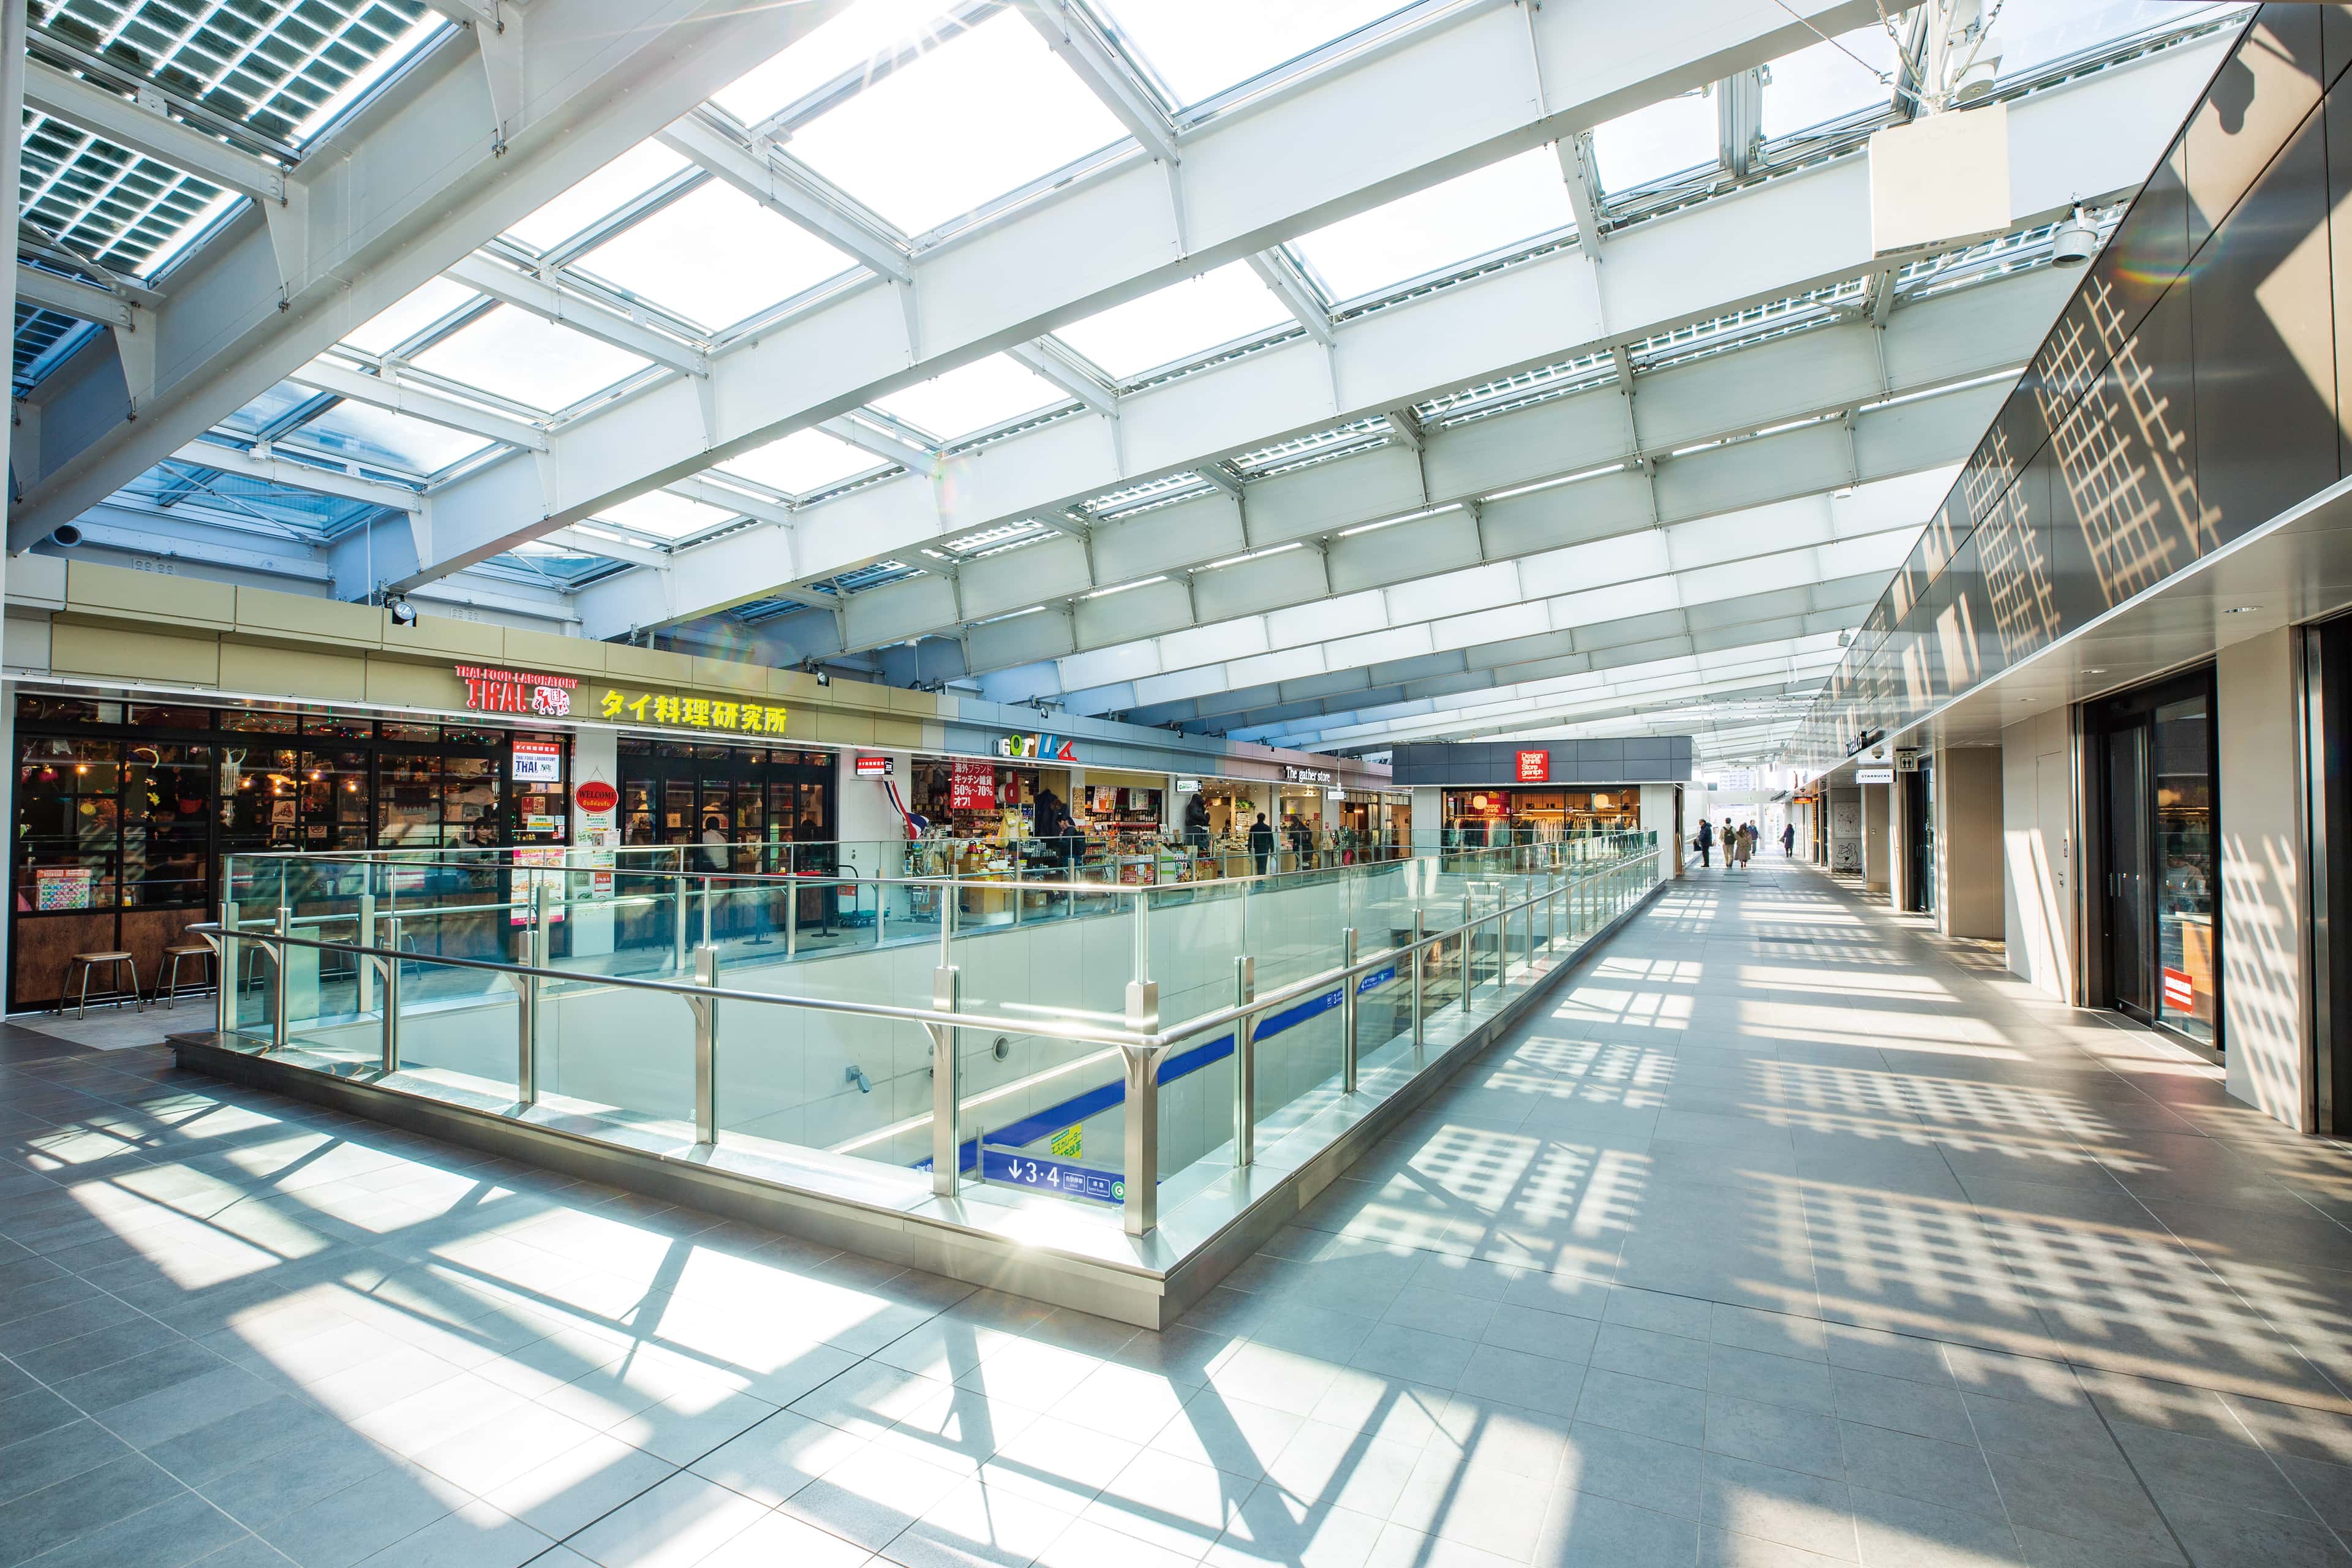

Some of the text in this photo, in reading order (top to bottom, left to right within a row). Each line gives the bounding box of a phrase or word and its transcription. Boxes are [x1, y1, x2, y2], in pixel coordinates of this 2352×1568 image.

[455, 665, 578, 689] THAI FOOD LABORATORY
[466, 679, 529, 712] THAI
[601, 690, 786, 733] タイ料理研究所
[516, 761, 538, 774] THAI
[954, 774, 992, 786] キッチン雑貨
[1286, 766, 1330, 783] The gather store
[578, 790, 615, 799] WELCOME
[1333, 993, 1336, 1004] 3
[1066, 1175, 1083, 1184] 各駅停車
